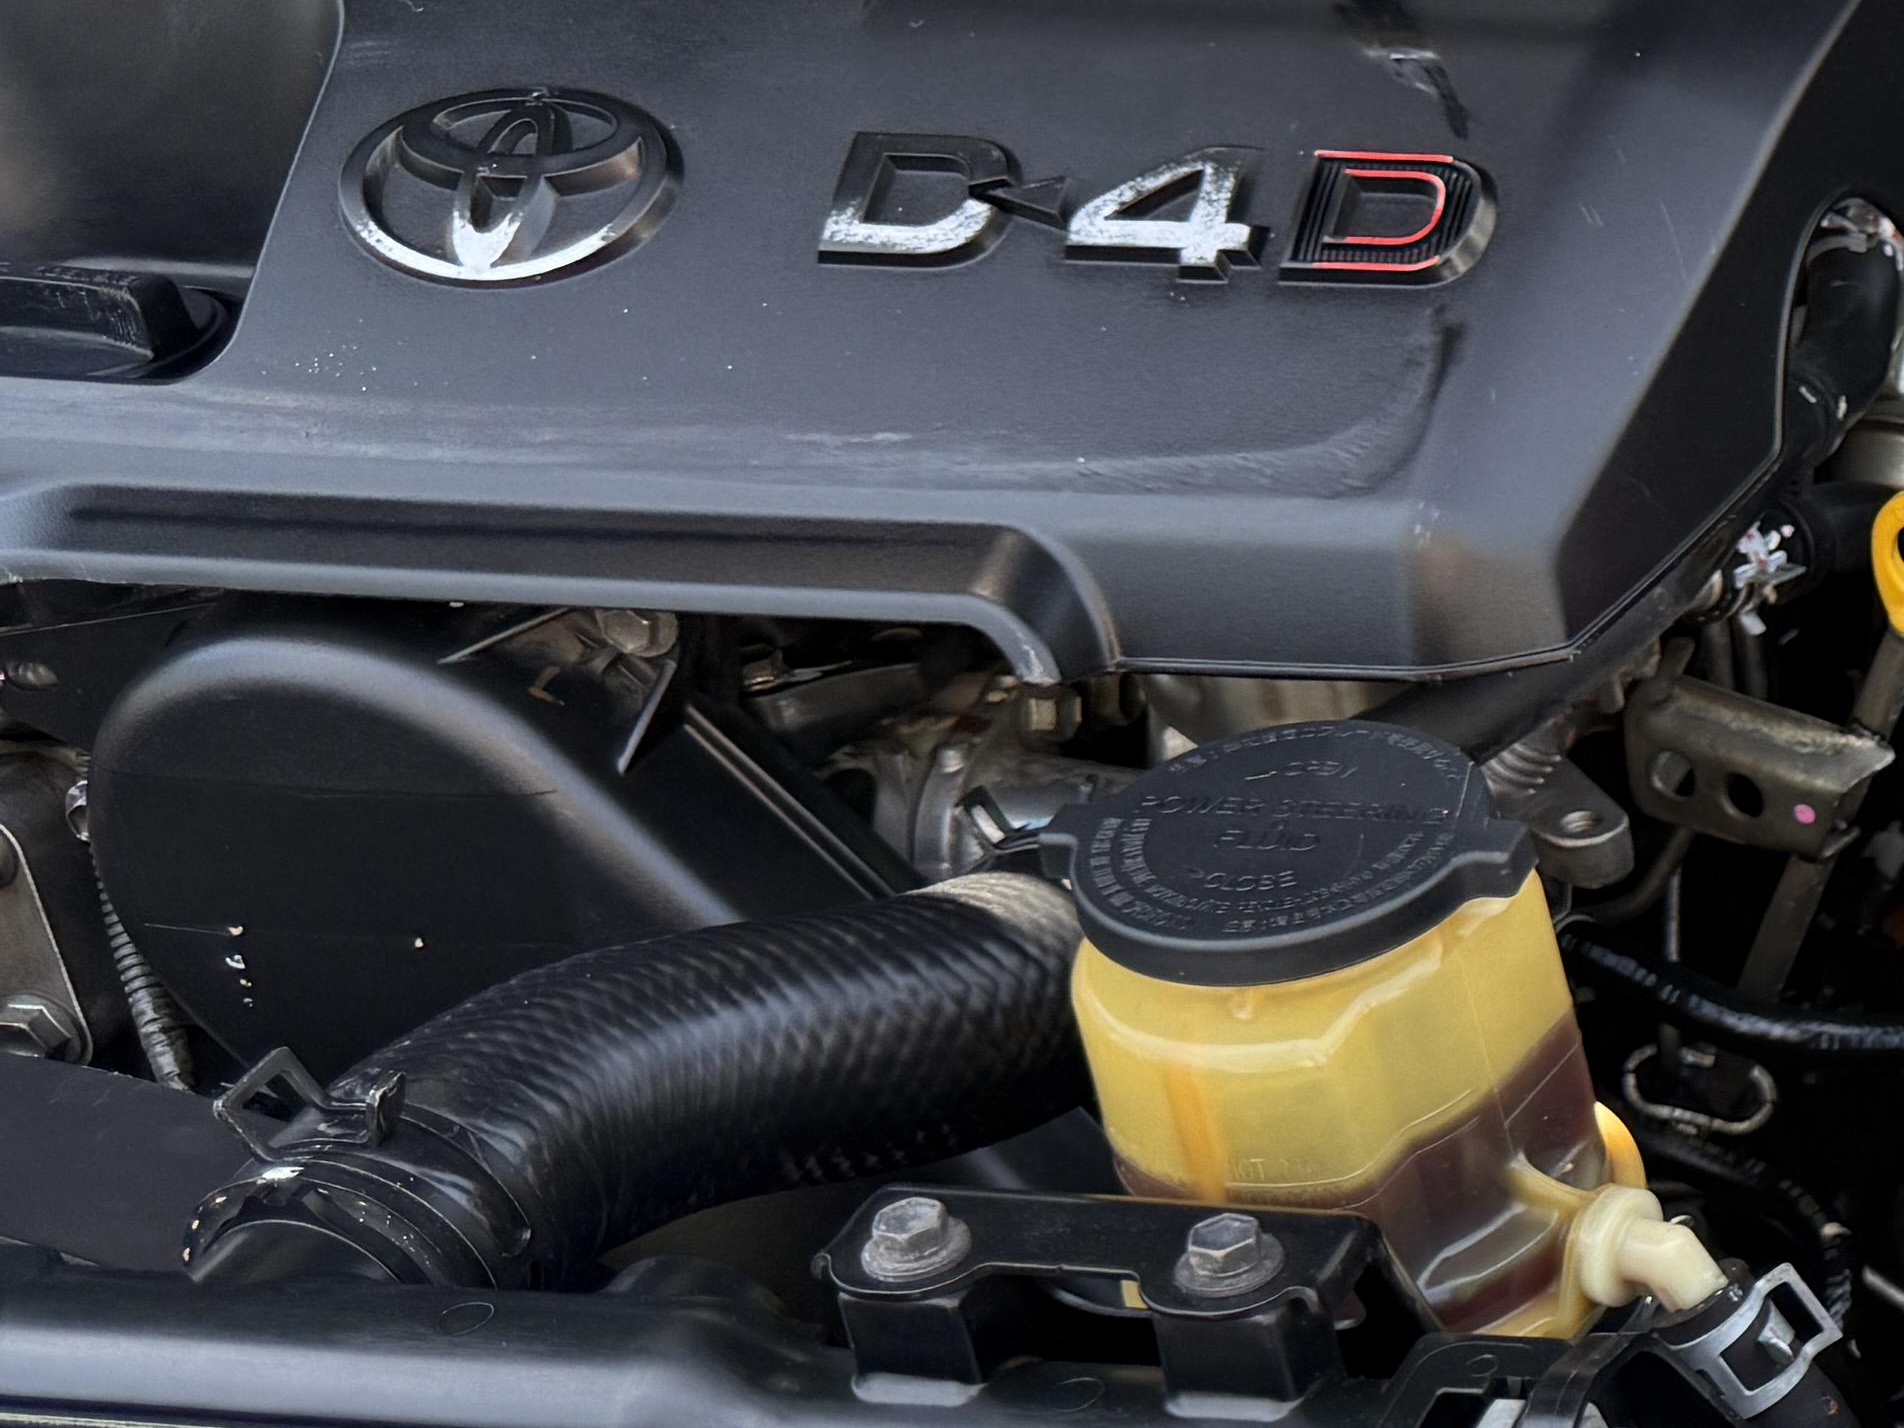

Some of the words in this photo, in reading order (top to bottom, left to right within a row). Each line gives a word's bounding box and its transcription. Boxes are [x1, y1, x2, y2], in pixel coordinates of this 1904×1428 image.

[818, 133, 1498, 285] D-4D
[1140, 796, 1265, 816] POWER
[1212, 828, 1321, 852] FLUID
